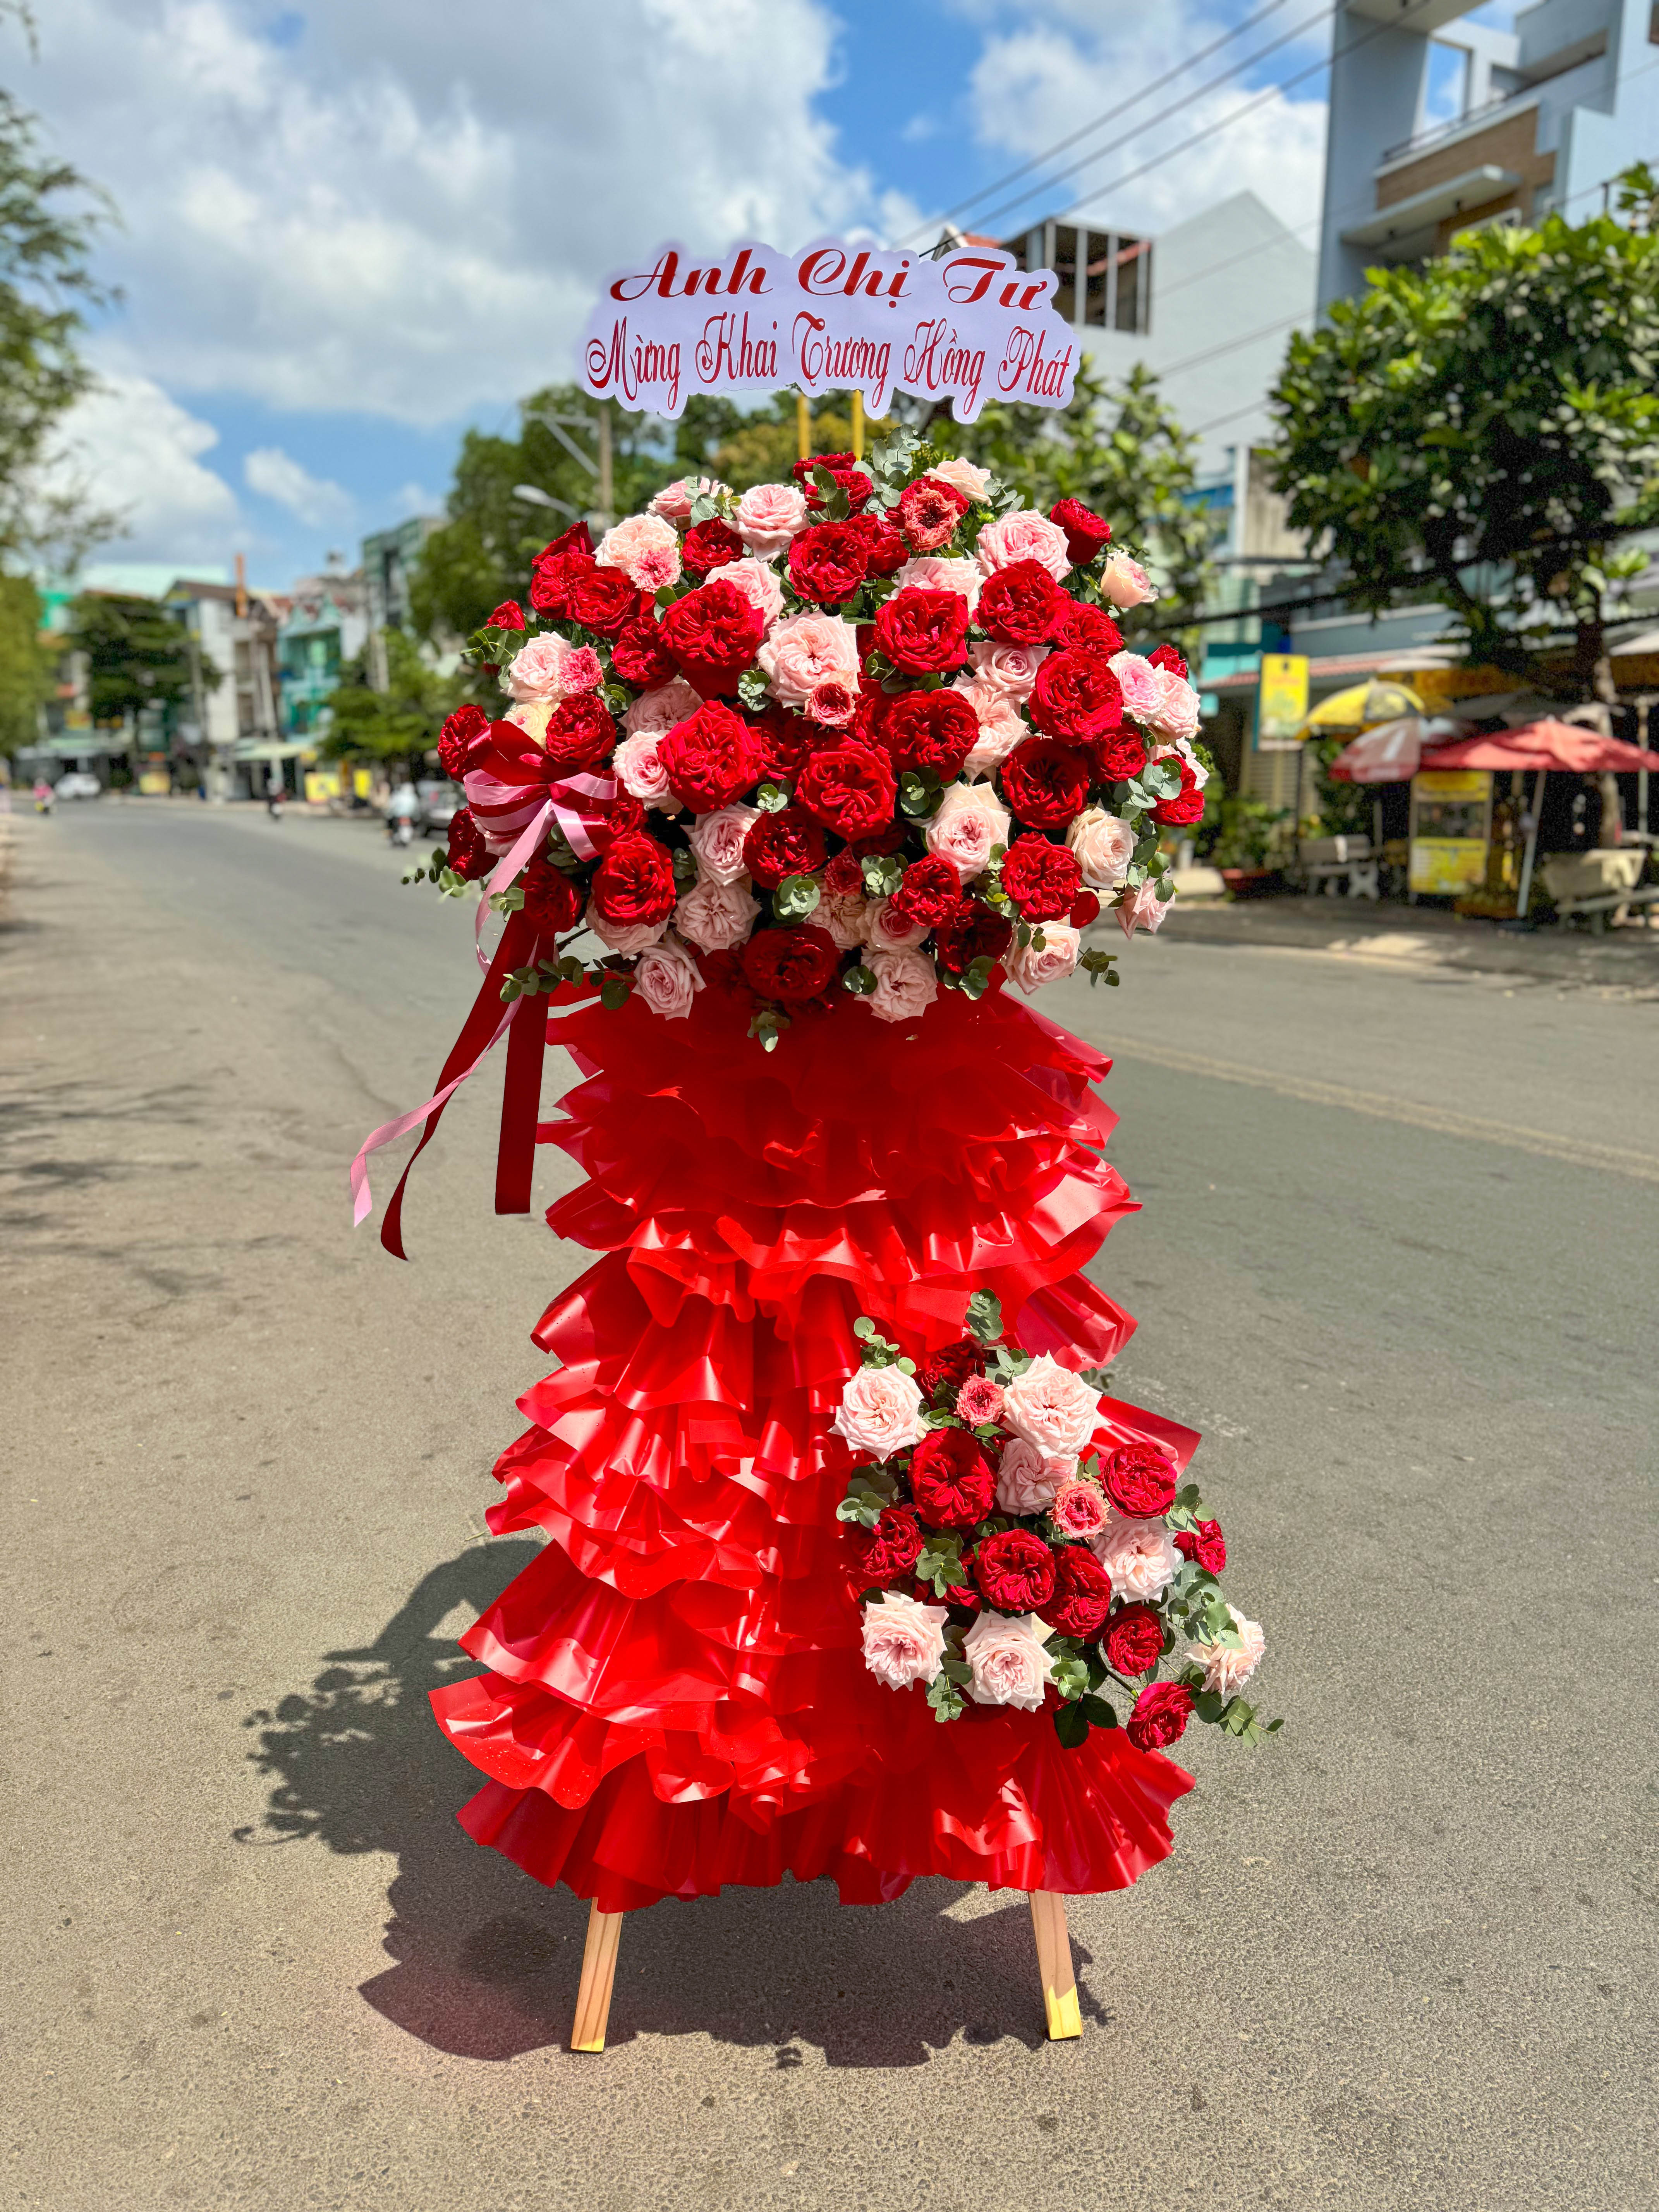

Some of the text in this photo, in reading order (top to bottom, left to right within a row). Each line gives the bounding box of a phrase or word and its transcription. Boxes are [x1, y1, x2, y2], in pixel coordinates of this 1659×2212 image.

[610, 249, 1048, 311] Anh Chị Tư
[586, 311, 1073, 415] Mừng Khai Trương Hồng Phát
